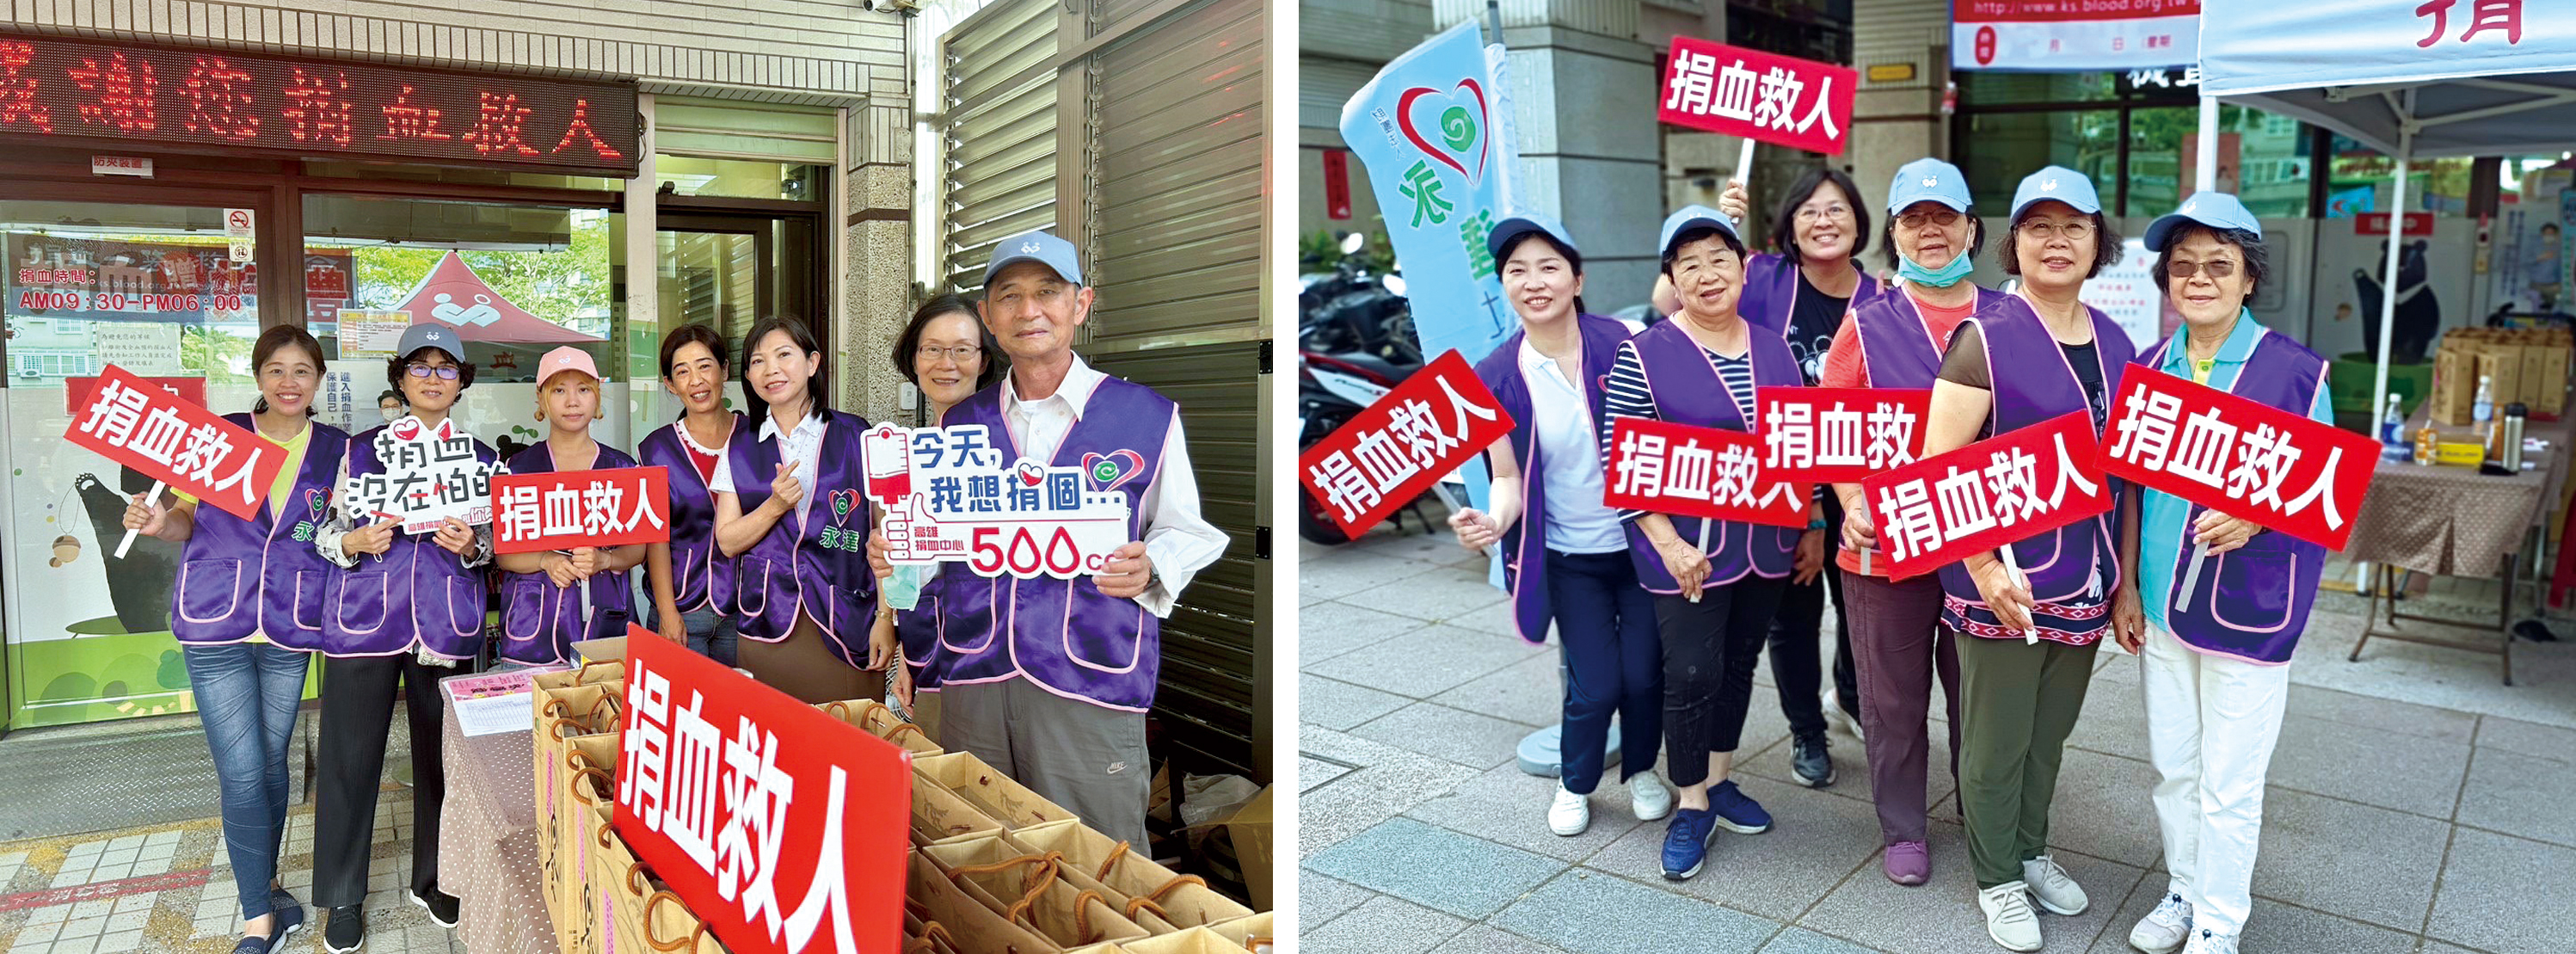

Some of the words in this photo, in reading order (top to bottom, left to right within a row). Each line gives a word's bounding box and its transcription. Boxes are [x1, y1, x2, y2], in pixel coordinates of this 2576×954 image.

[1669, 48, 1840, 140] 捐血救人
[94, 156, 143, 169] 防夾裝置
[79, 379, 263, 506] 捐血救人
[378, 422, 473, 470] 捐血
[1308, 374, 1497, 524] 捐血救人
[1763, 401, 1925, 471] 捐血救
[2110, 382, 2346, 533] 捐血救人
[499, 477, 666, 543] 捐血救人
[1877, 432, 2099, 563] 捐血救人
[291, 520, 315, 543] 永
[819, 525, 860, 553] 永達
[913, 526, 939, 538] 高雄
[915, 539, 964, 551] 捐血中心
[1110, 760, 1125, 770] NIKE
[619, 657, 858, 954] 捐血救人
